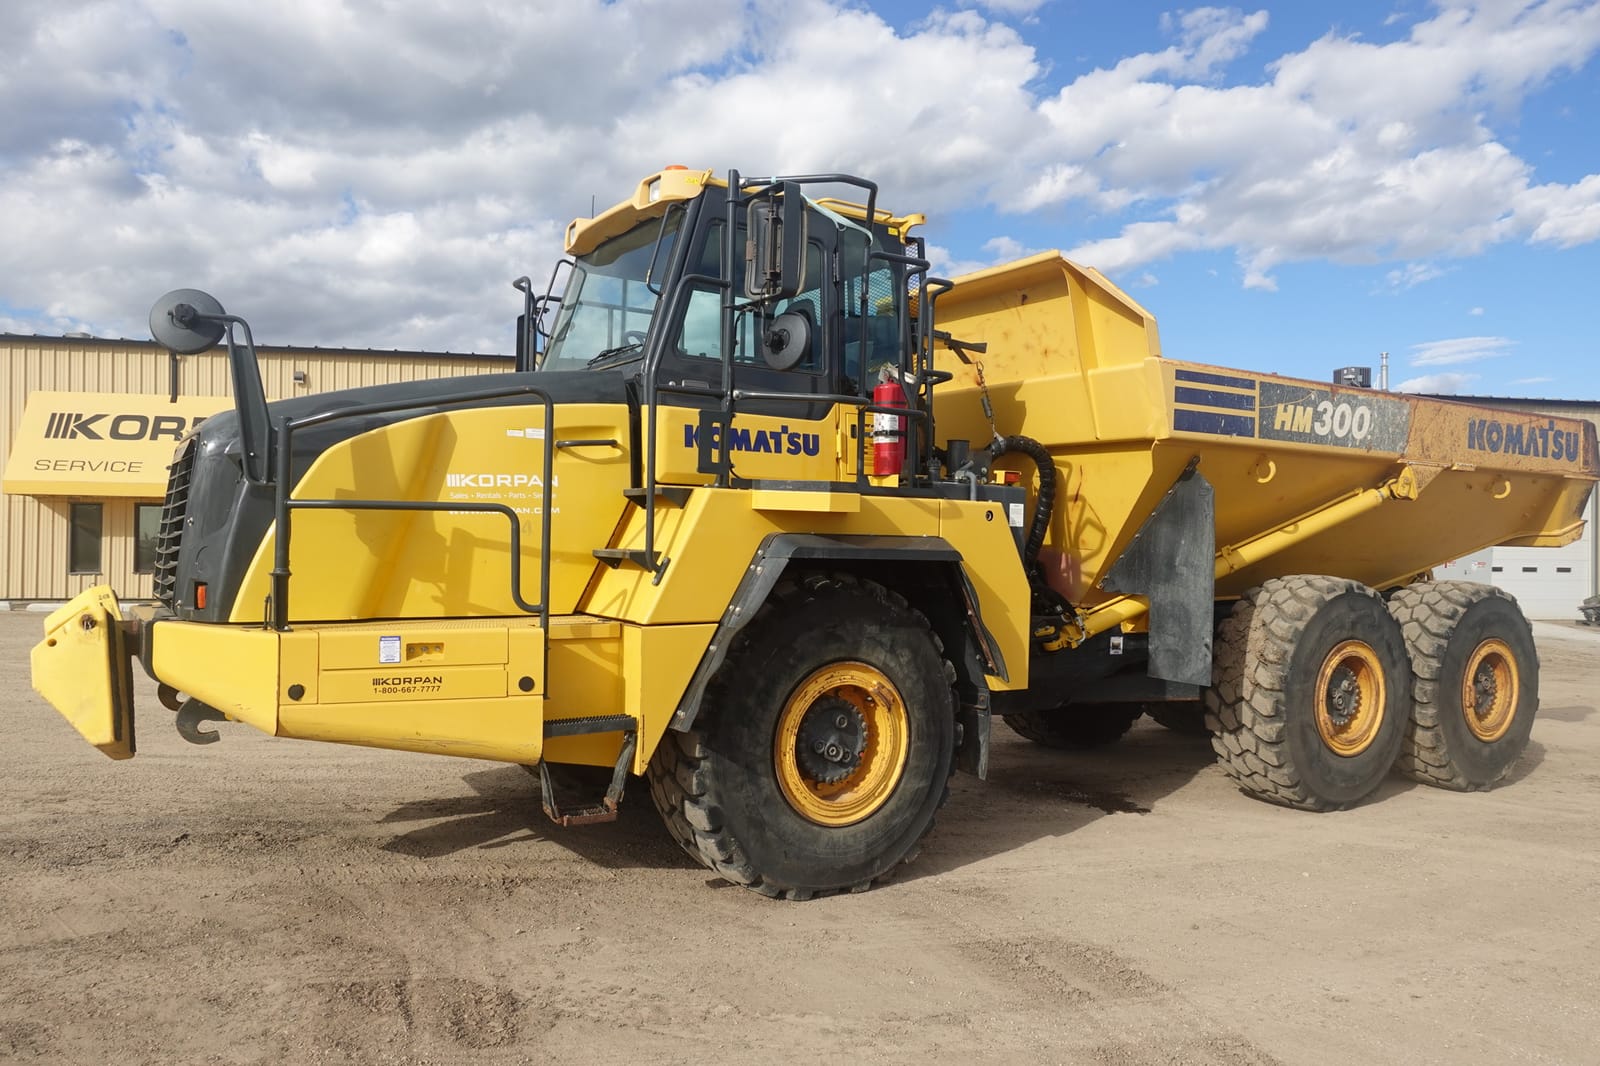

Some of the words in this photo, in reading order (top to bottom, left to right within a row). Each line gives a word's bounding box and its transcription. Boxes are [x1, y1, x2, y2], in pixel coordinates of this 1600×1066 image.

[44, 412, 208, 442] KOR
[1467, 417, 1580, 463] KOMATSU
[34, 459, 144, 473] SERVICE
[372, 676, 442, 686] KORPAN
[374, 685, 441, 694] 1-800-667-7777
